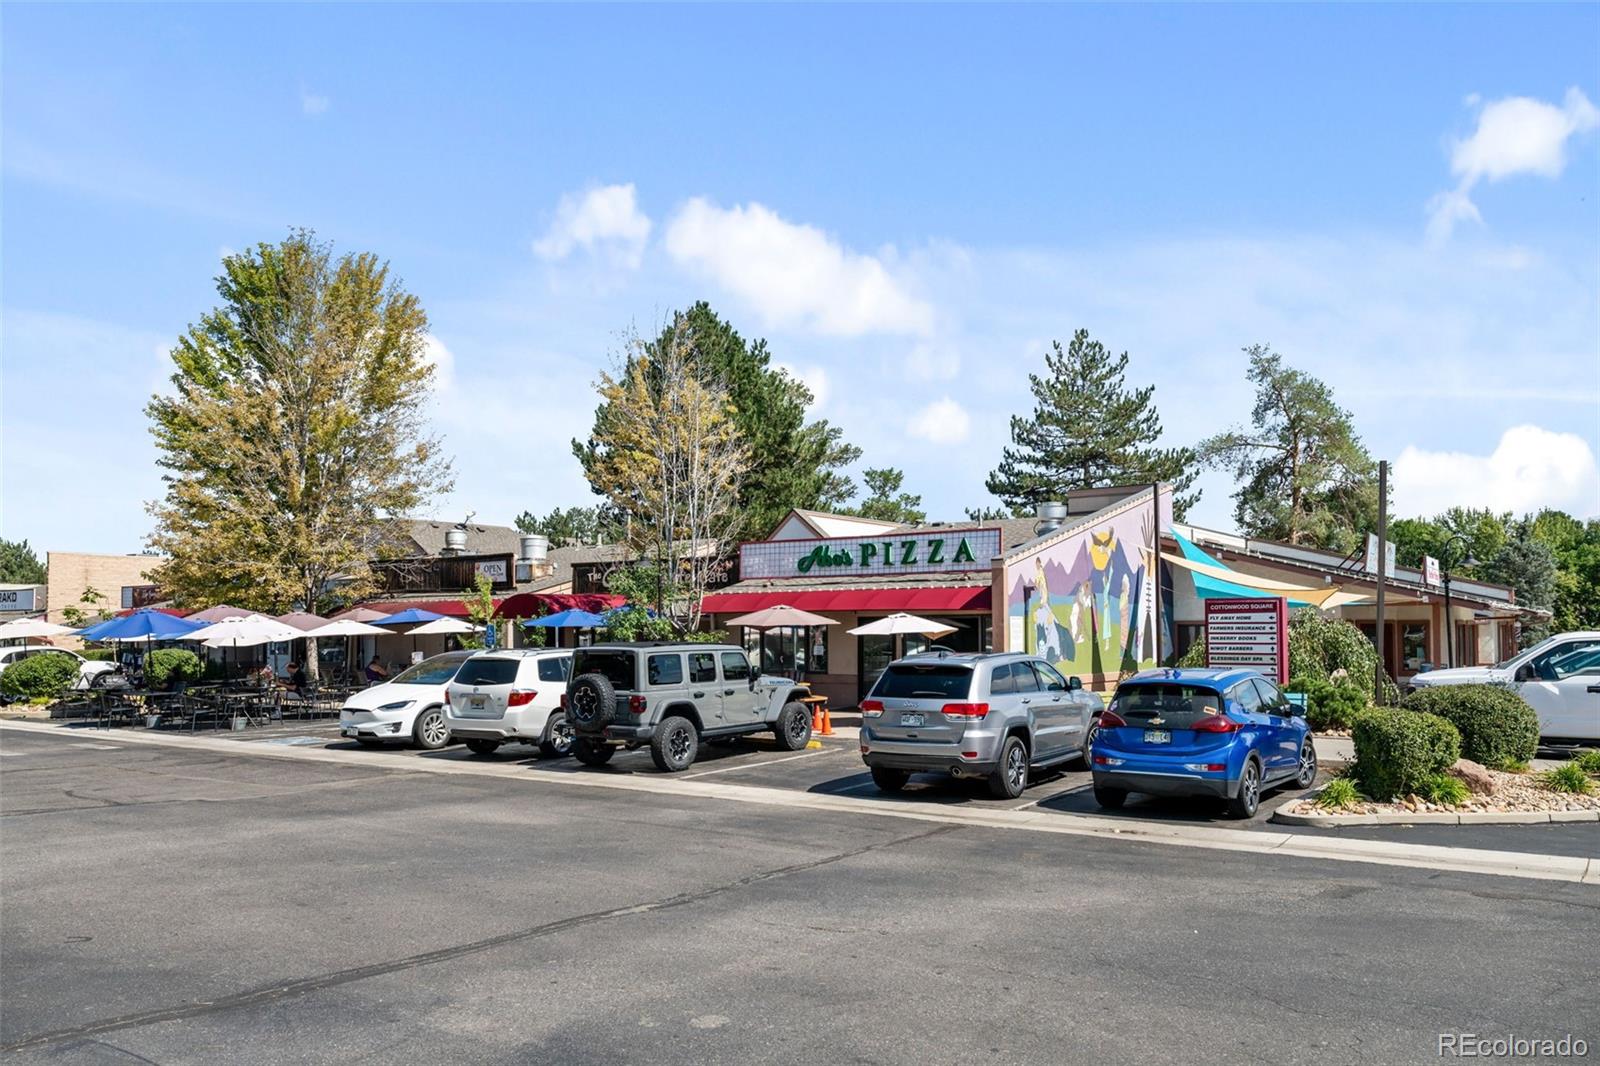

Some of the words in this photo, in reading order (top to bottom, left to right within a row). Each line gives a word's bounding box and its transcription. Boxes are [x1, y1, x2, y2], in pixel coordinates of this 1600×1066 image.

[797, 545, 854, 573] Abo's
[858, 537, 977, 567] PIZZA
[483, 564, 502, 574] OPEN
